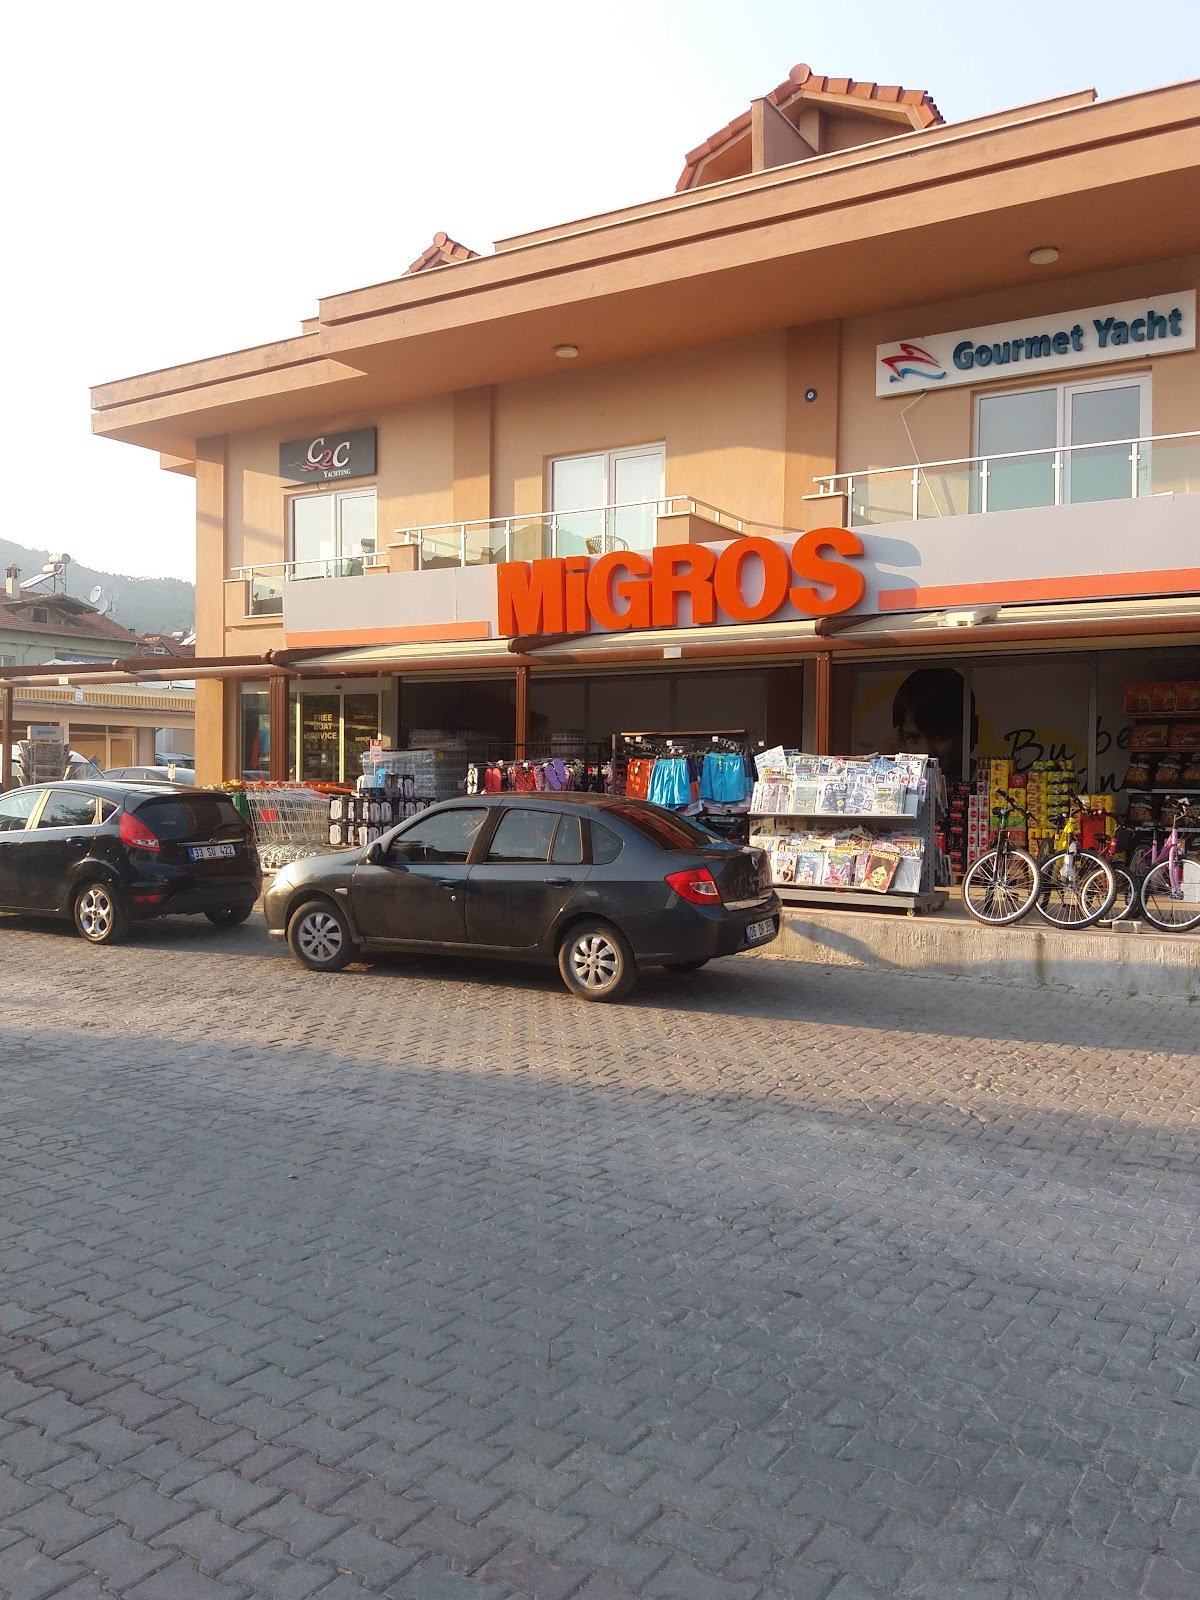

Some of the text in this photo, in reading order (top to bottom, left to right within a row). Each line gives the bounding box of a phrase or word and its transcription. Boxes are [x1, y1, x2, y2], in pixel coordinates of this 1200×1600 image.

[952, 307, 1182, 370] Gourmet Yacht
[307, 437, 350, 467] C2C
[1003, 728, 1076, 771] Bu
[194, 848, 203, 857] 33
[220, 846, 233, 855] 422
